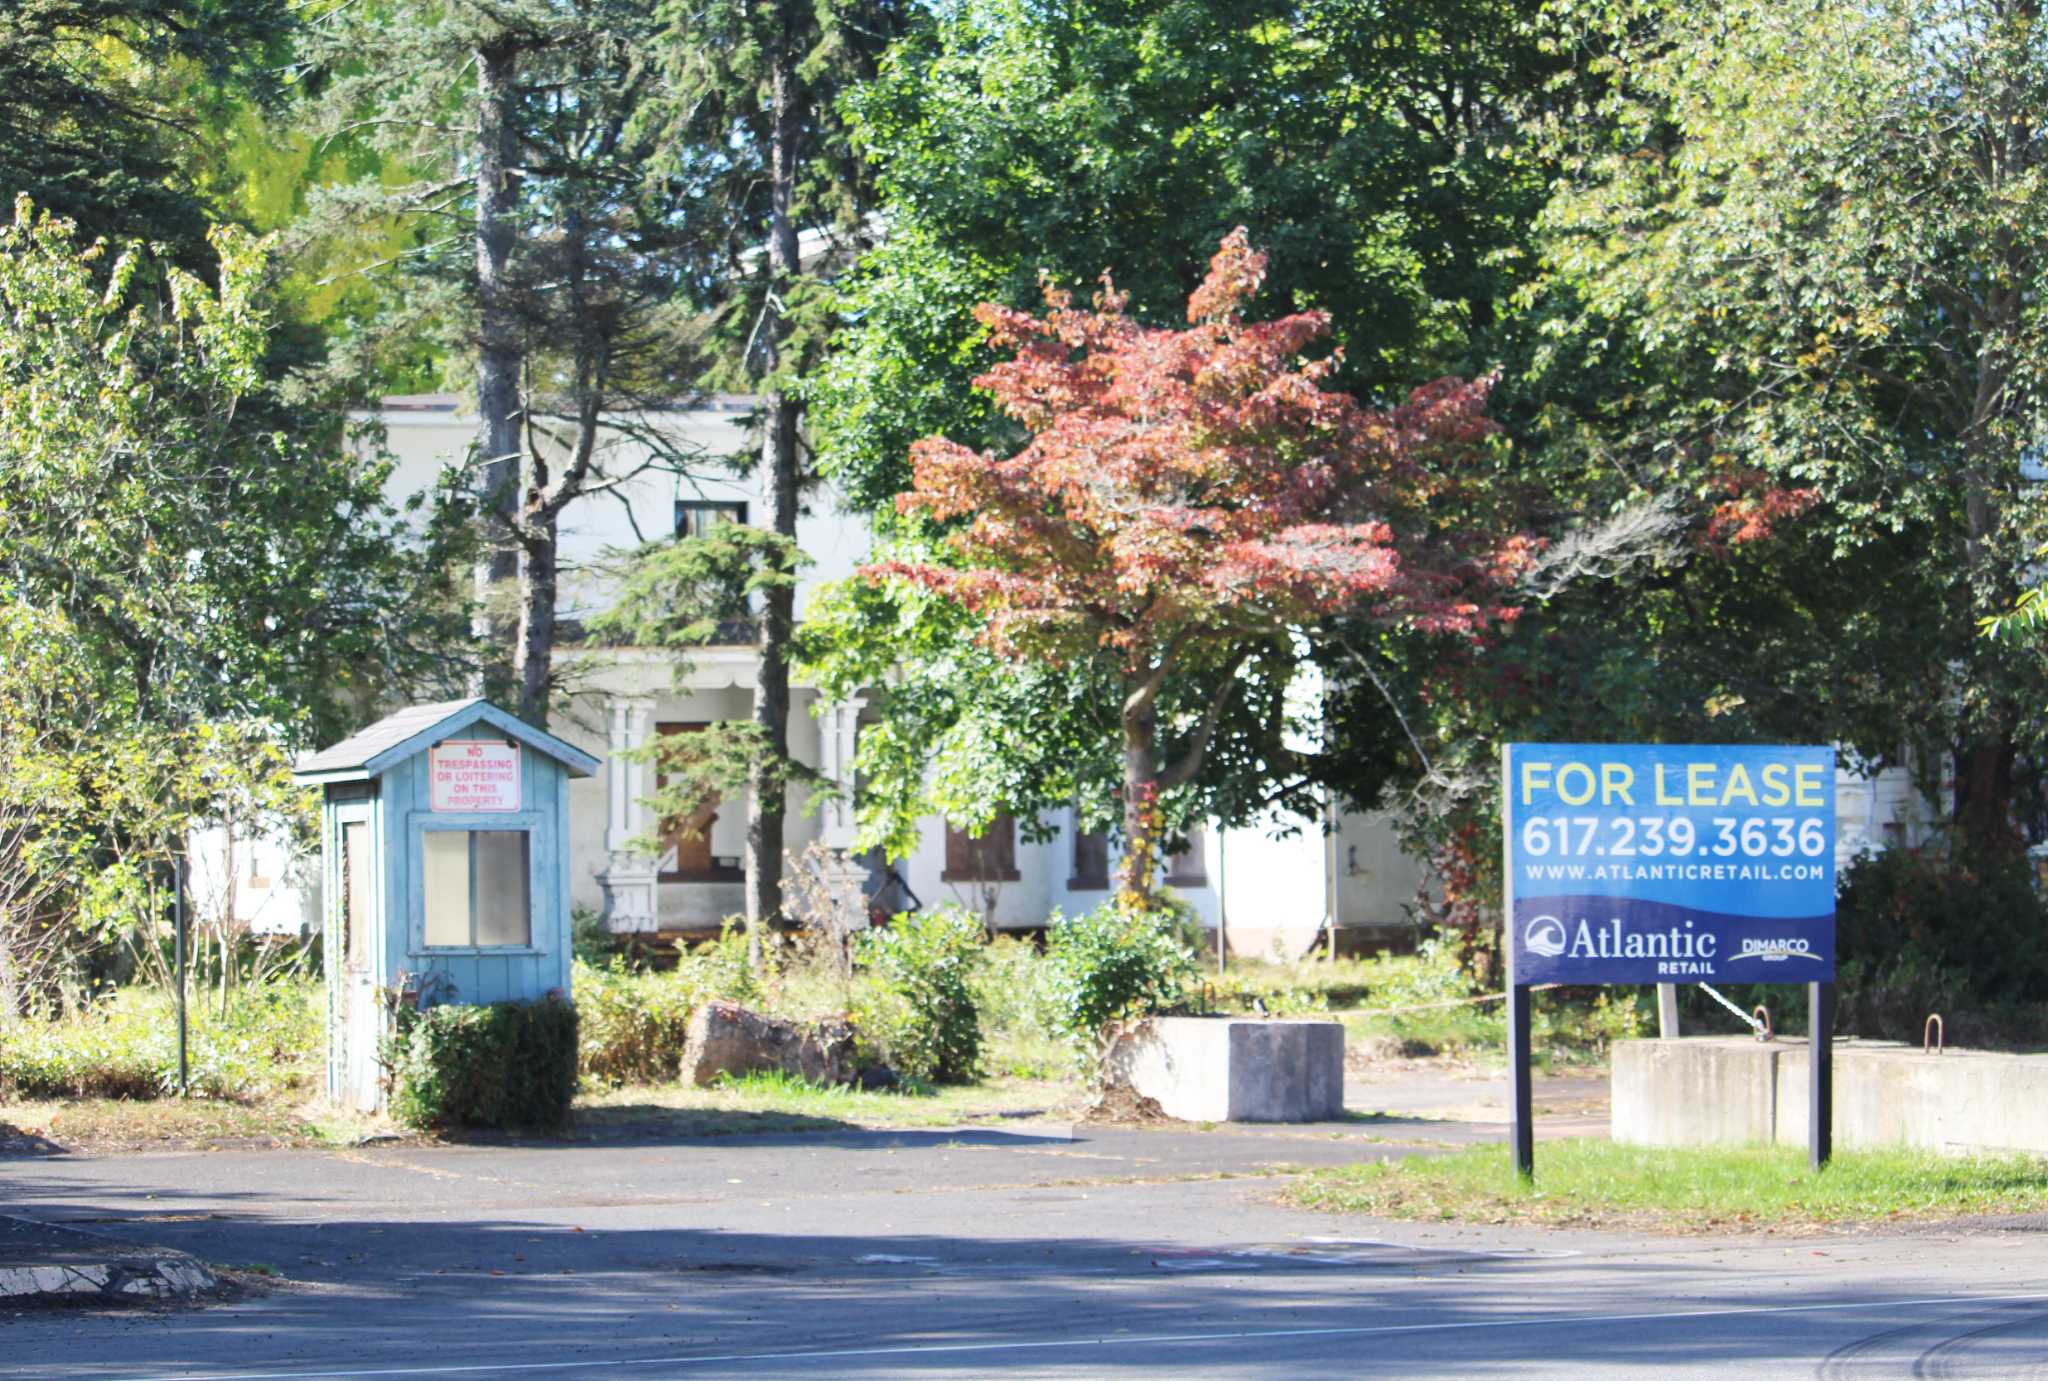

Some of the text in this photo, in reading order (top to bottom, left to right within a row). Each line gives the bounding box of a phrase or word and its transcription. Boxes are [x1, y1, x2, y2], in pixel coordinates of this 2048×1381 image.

[467, 747, 482, 757] NO
[437, 772, 513, 781] OR LOITERING
[453, 784, 469, 793] ON
[1521, 762, 1825, 807] FOR LEASE
[1522, 817, 1825, 857] 617.239.3636
[1526, 864, 1824, 880] WWW.ATLANTICRETAIL.COM
[1568, 918, 1716, 959] Atlantic
[1742, 938, 1809, 953] DIMARCO
[1658, 962, 1715, 975] RETAIL
